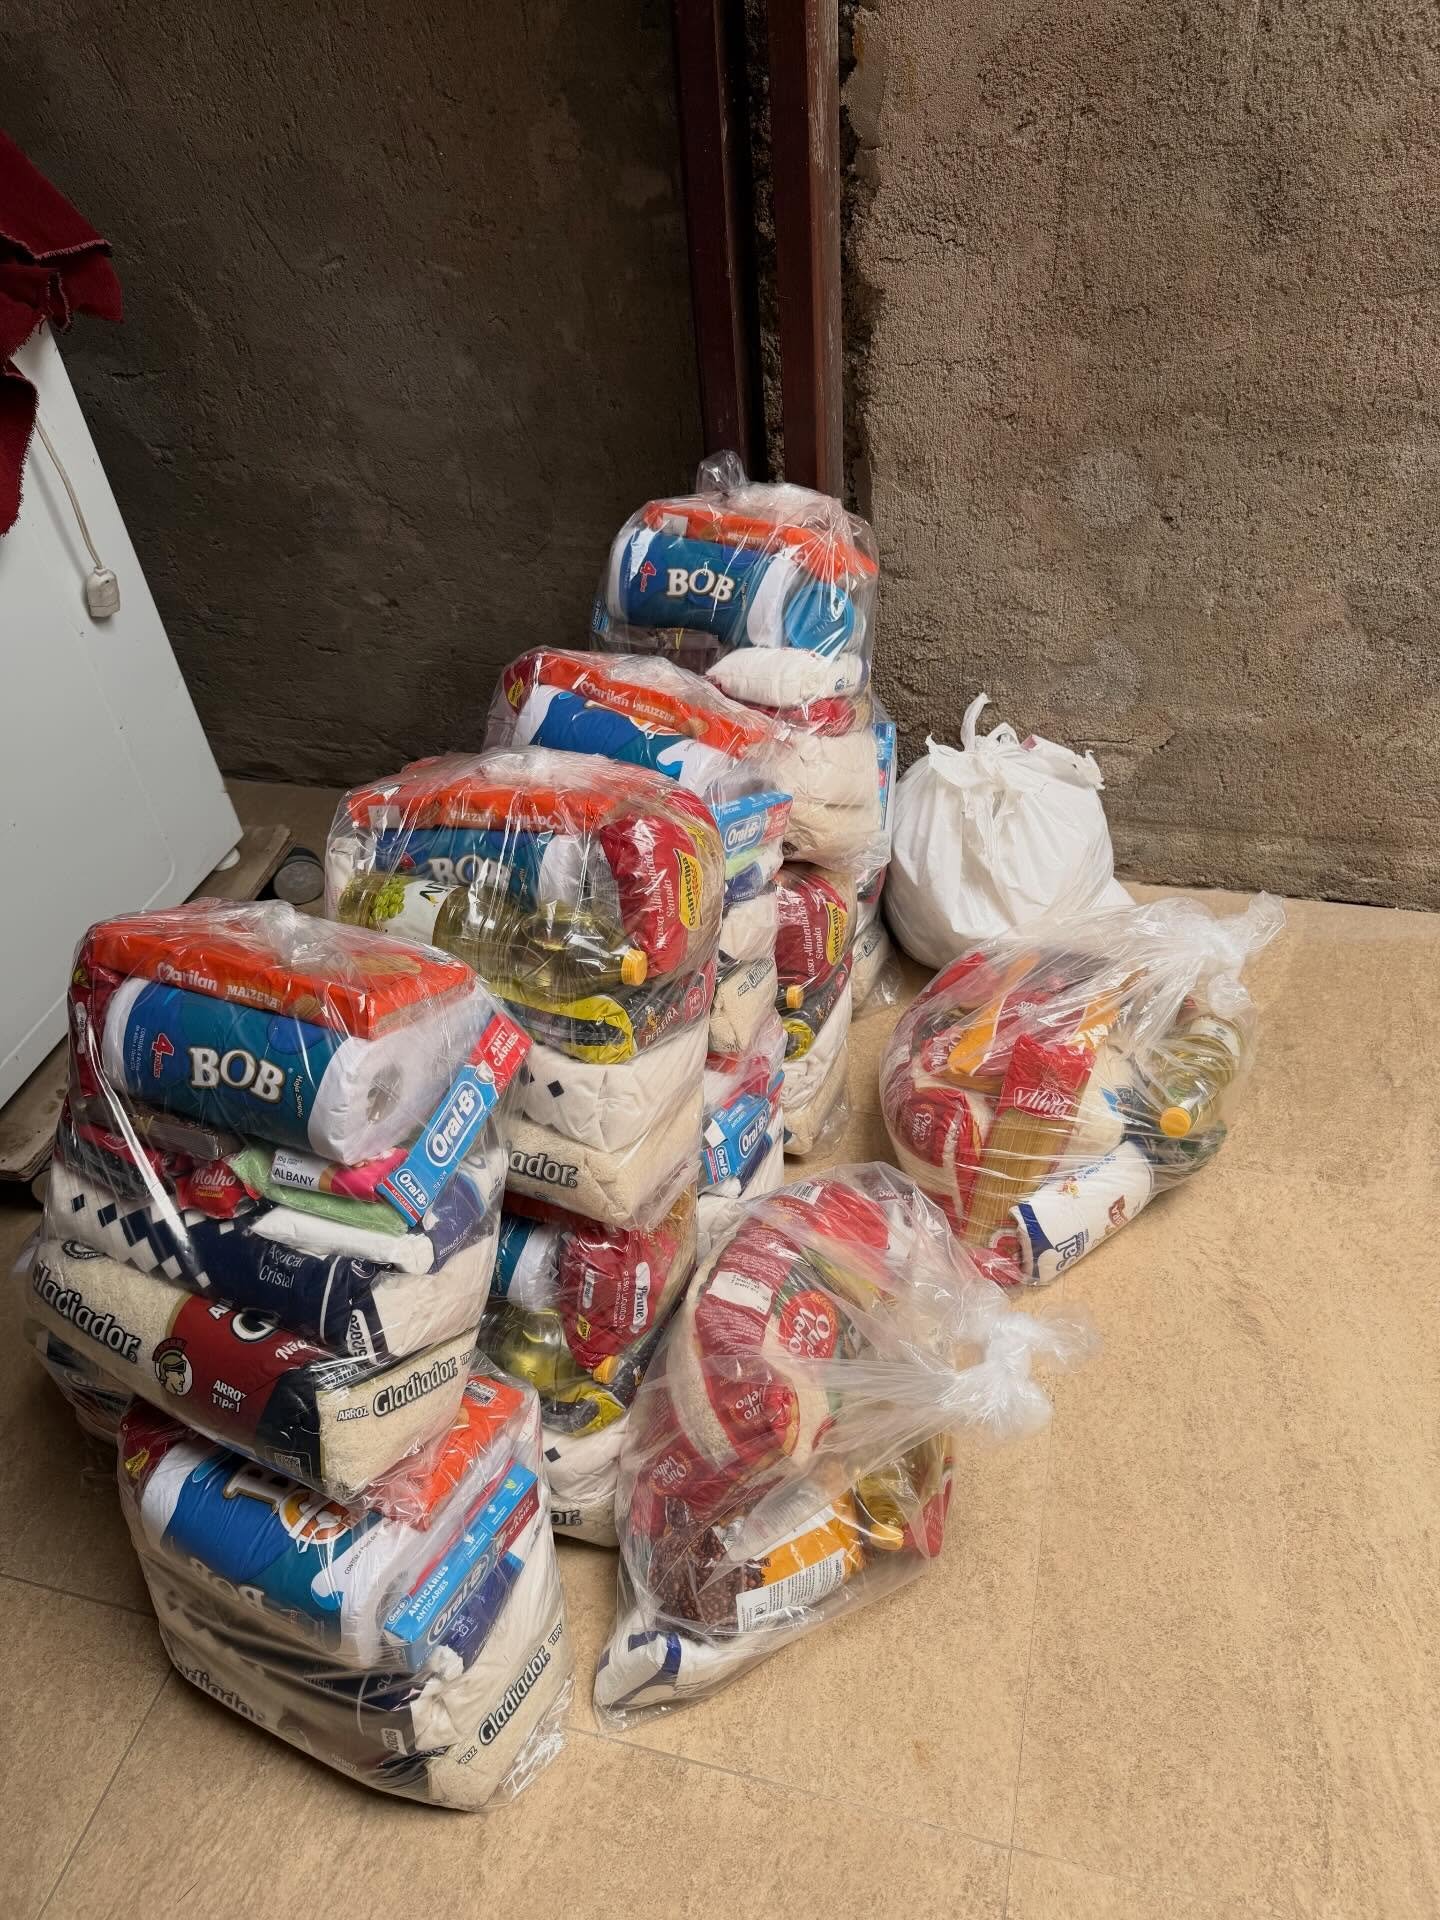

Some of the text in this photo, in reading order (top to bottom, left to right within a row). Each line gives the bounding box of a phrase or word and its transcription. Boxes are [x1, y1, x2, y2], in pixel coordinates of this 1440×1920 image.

[666, 567, 735, 601] BOB
[580, 681, 629, 708] Marilan
[727, 821, 760, 847] Oral-B
[156, 961, 278, 1009] Marilan MAIZENA
[490, 1028, 507, 1055] ANTI
[644, 1007, 680, 1045] PEREIRA
[152, 1032, 175, 1057] 4
[187, 1045, 286, 1104] BOB
[432, 1090, 476, 1158] Oral-B
[742, 1115, 766, 1152] Oral-B
[190, 1167, 236, 1187] Molho
[274, 1167, 315, 1187] ALBANY
[399, 1173, 428, 1206] Oral-B
[1056, 1234, 1079, 1271] Sal
[258, 1265, 295, 1289] Cristal
[337, 1406, 369, 1422] ARROZ
[373, 1357, 456, 1417] Gladiador
[744, 1399, 765, 1421] uro
[480, 1645, 549, 1745] Gladiador
[548, 1623, 562, 1646] TIPO
